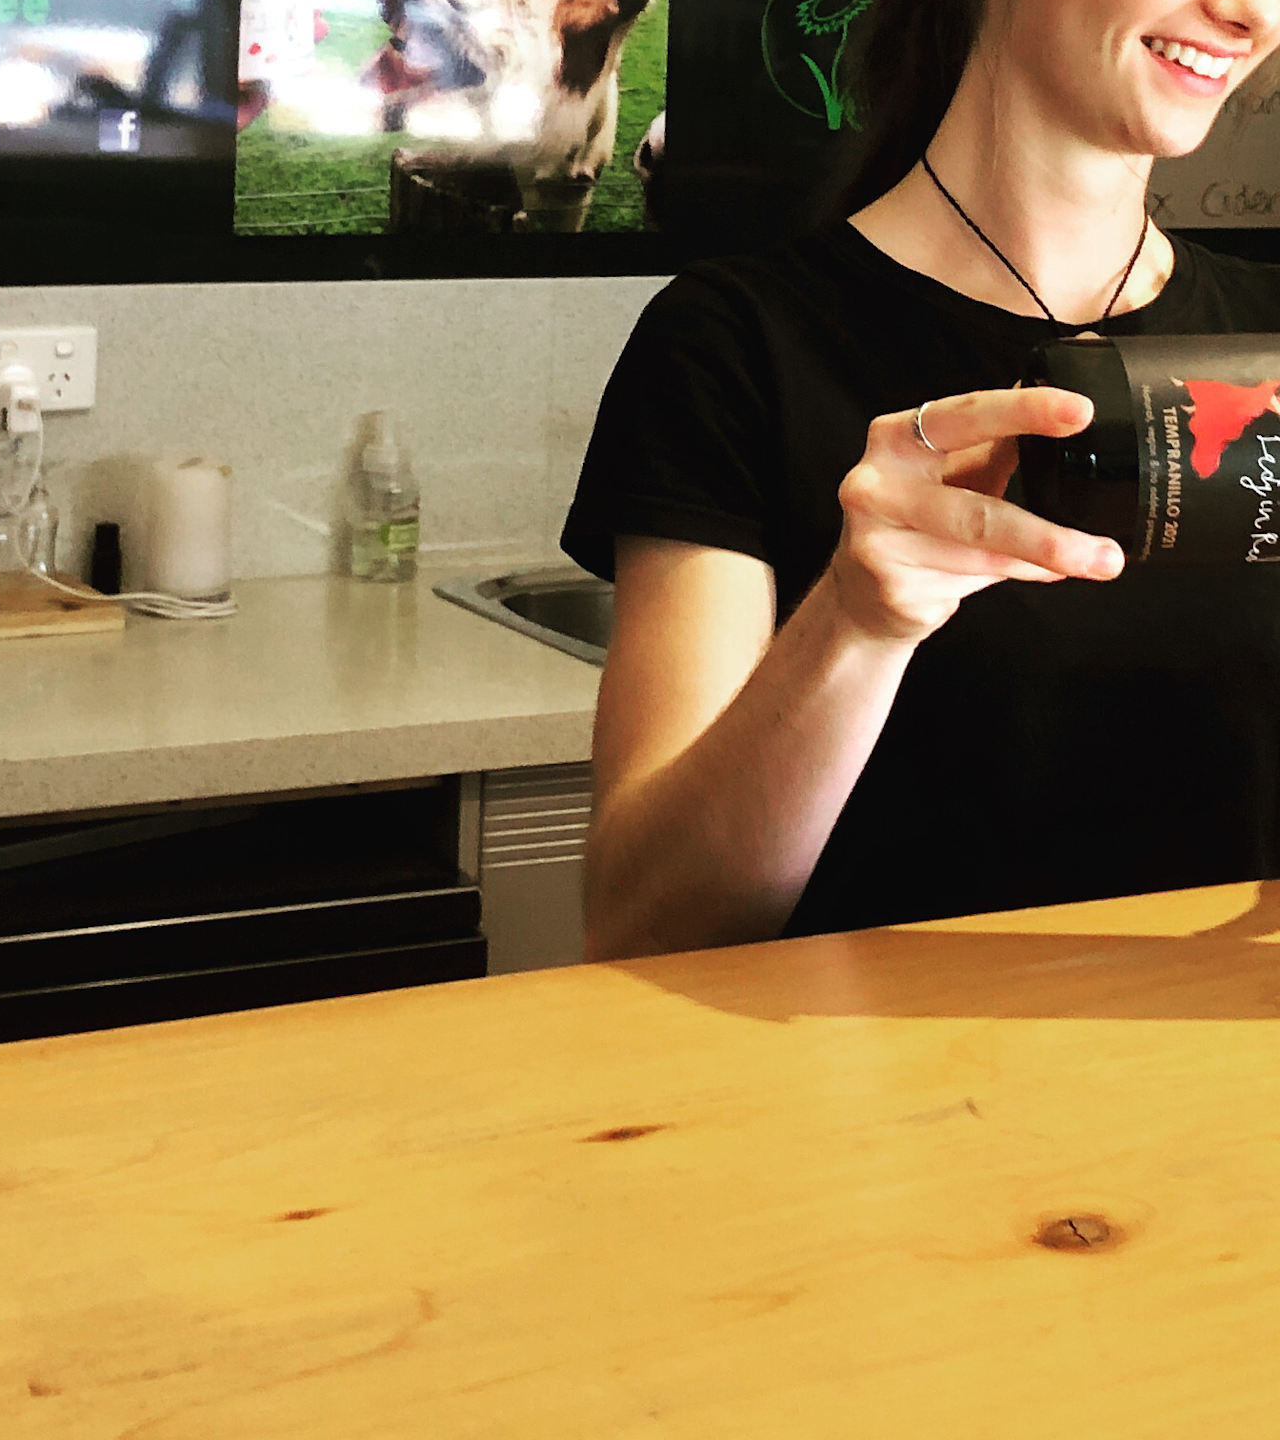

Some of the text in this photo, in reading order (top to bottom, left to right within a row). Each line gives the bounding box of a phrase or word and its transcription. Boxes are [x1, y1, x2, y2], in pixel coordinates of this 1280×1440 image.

[1160, 406, 1182, 550] TEMPRANILLO 2021
[1253, 498, 1280, 530] in
